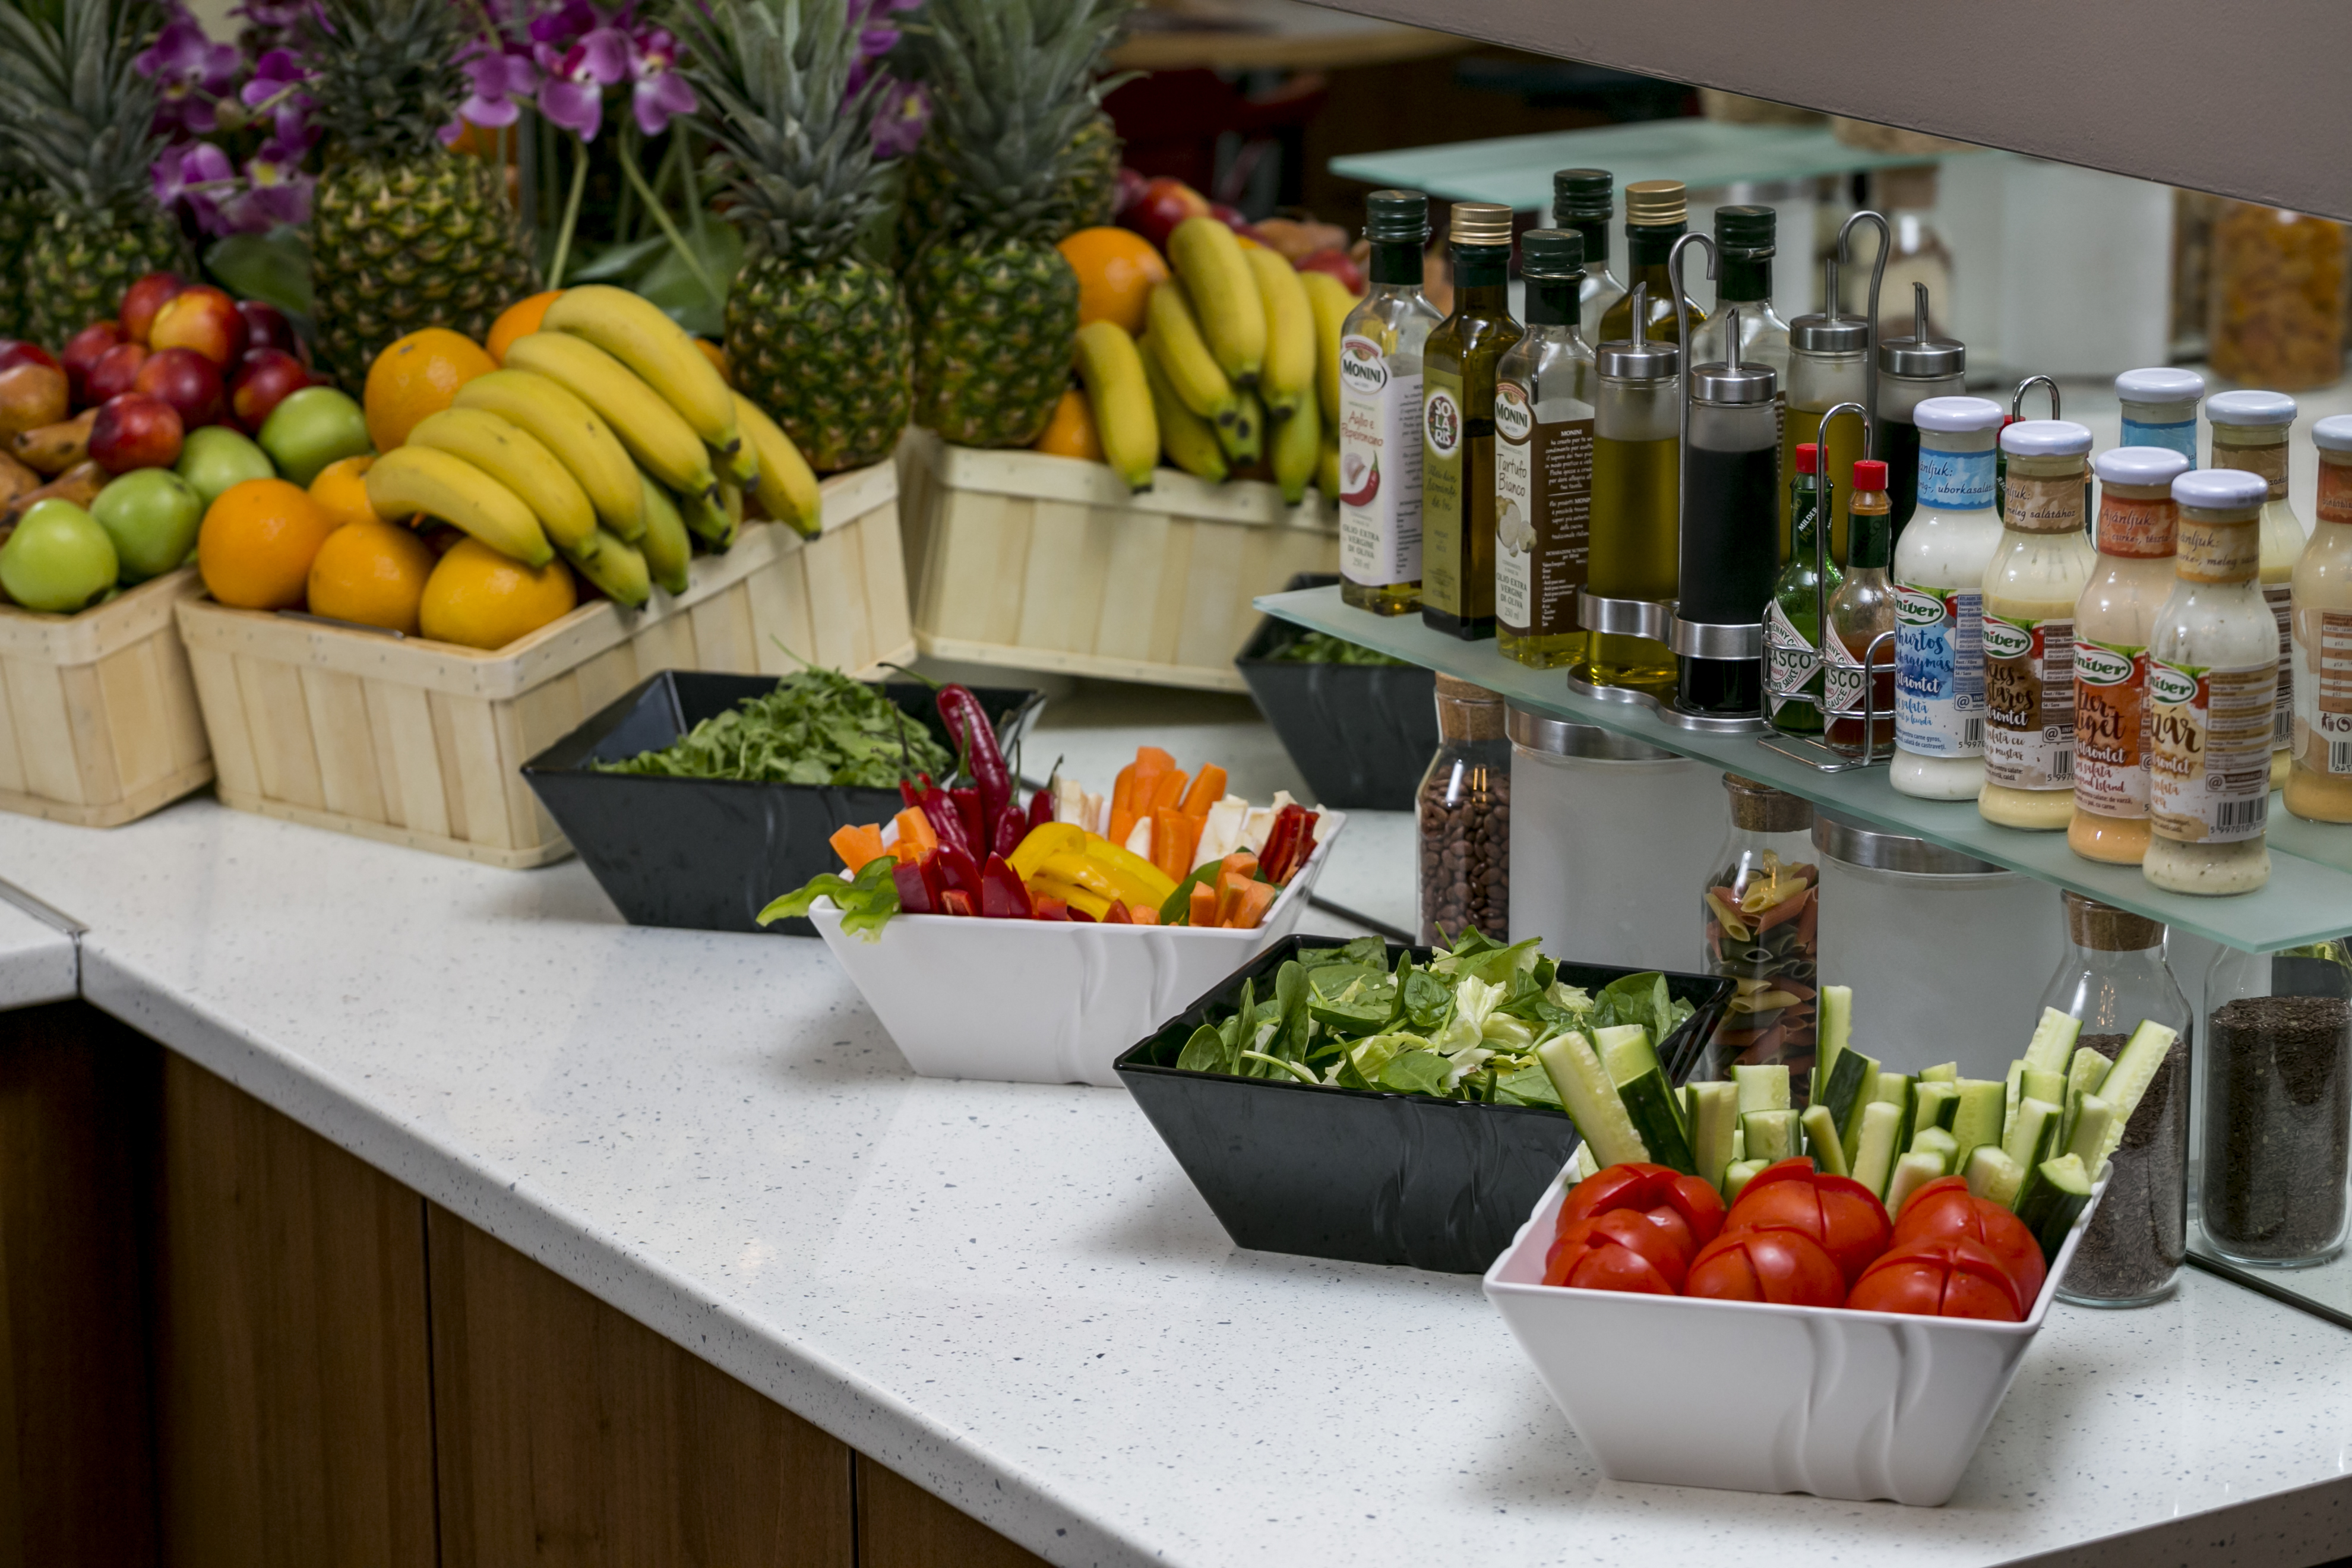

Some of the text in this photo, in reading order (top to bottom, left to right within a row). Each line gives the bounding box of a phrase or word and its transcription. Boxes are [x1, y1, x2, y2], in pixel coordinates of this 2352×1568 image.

[1343, 359, 1381, 383] MONINI
[1434, 399, 1451, 417] SO
[1496, 402, 1528, 428] MONINI
[1348, 410, 1368, 430] Aglio
[1435, 415, 1451, 432] LA
[1342, 422, 1384, 447] Peperoncino
[1434, 430, 1451, 445] RIS
[1497, 454, 1527, 478] Tartufo
[1920, 460, 1953, 480] ánljuk:
[1499, 473, 1526, 497] Bianco
[2006, 505, 2075, 521] meleg salátához
[2102, 508, 2156, 530] Ajánljuk:
[1342, 523, 1380, 542] OLIO EXTRA
[1348, 535, 1374, 549] VERGINE
[2112, 532, 2142, 545] csirke-,
[1356, 546, 1375, 558] OLIVA
[2206, 554, 2237, 571] meleg
[1497, 572, 1509, 583] OLIO
[1510, 578, 1527, 592] EXTRA
[1501, 583, 1523, 599] VERGINE
[1507, 596, 1523, 609] OLIVA
[1771, 650, 1812, 669] ASCO
[1782, 669, 1798, 688] SAUCE
[1826, 668, 1861, 689] ASCO
[1895, 668, 1940, 694] látaöntet
[2150, 675, 2191, 695] niver
[1828, 688, 1847, 709] SAUCE
[1902, 730, 1914, 738] pentru
[2012, 737, 2026, 745] cu
[1995, 747, 2024, 761] muștar
[2076, 736, 2127, 764] látaöntet
[2095, 778, 2126, 793] Island
[2219, 824, 2250, 834] 997010
